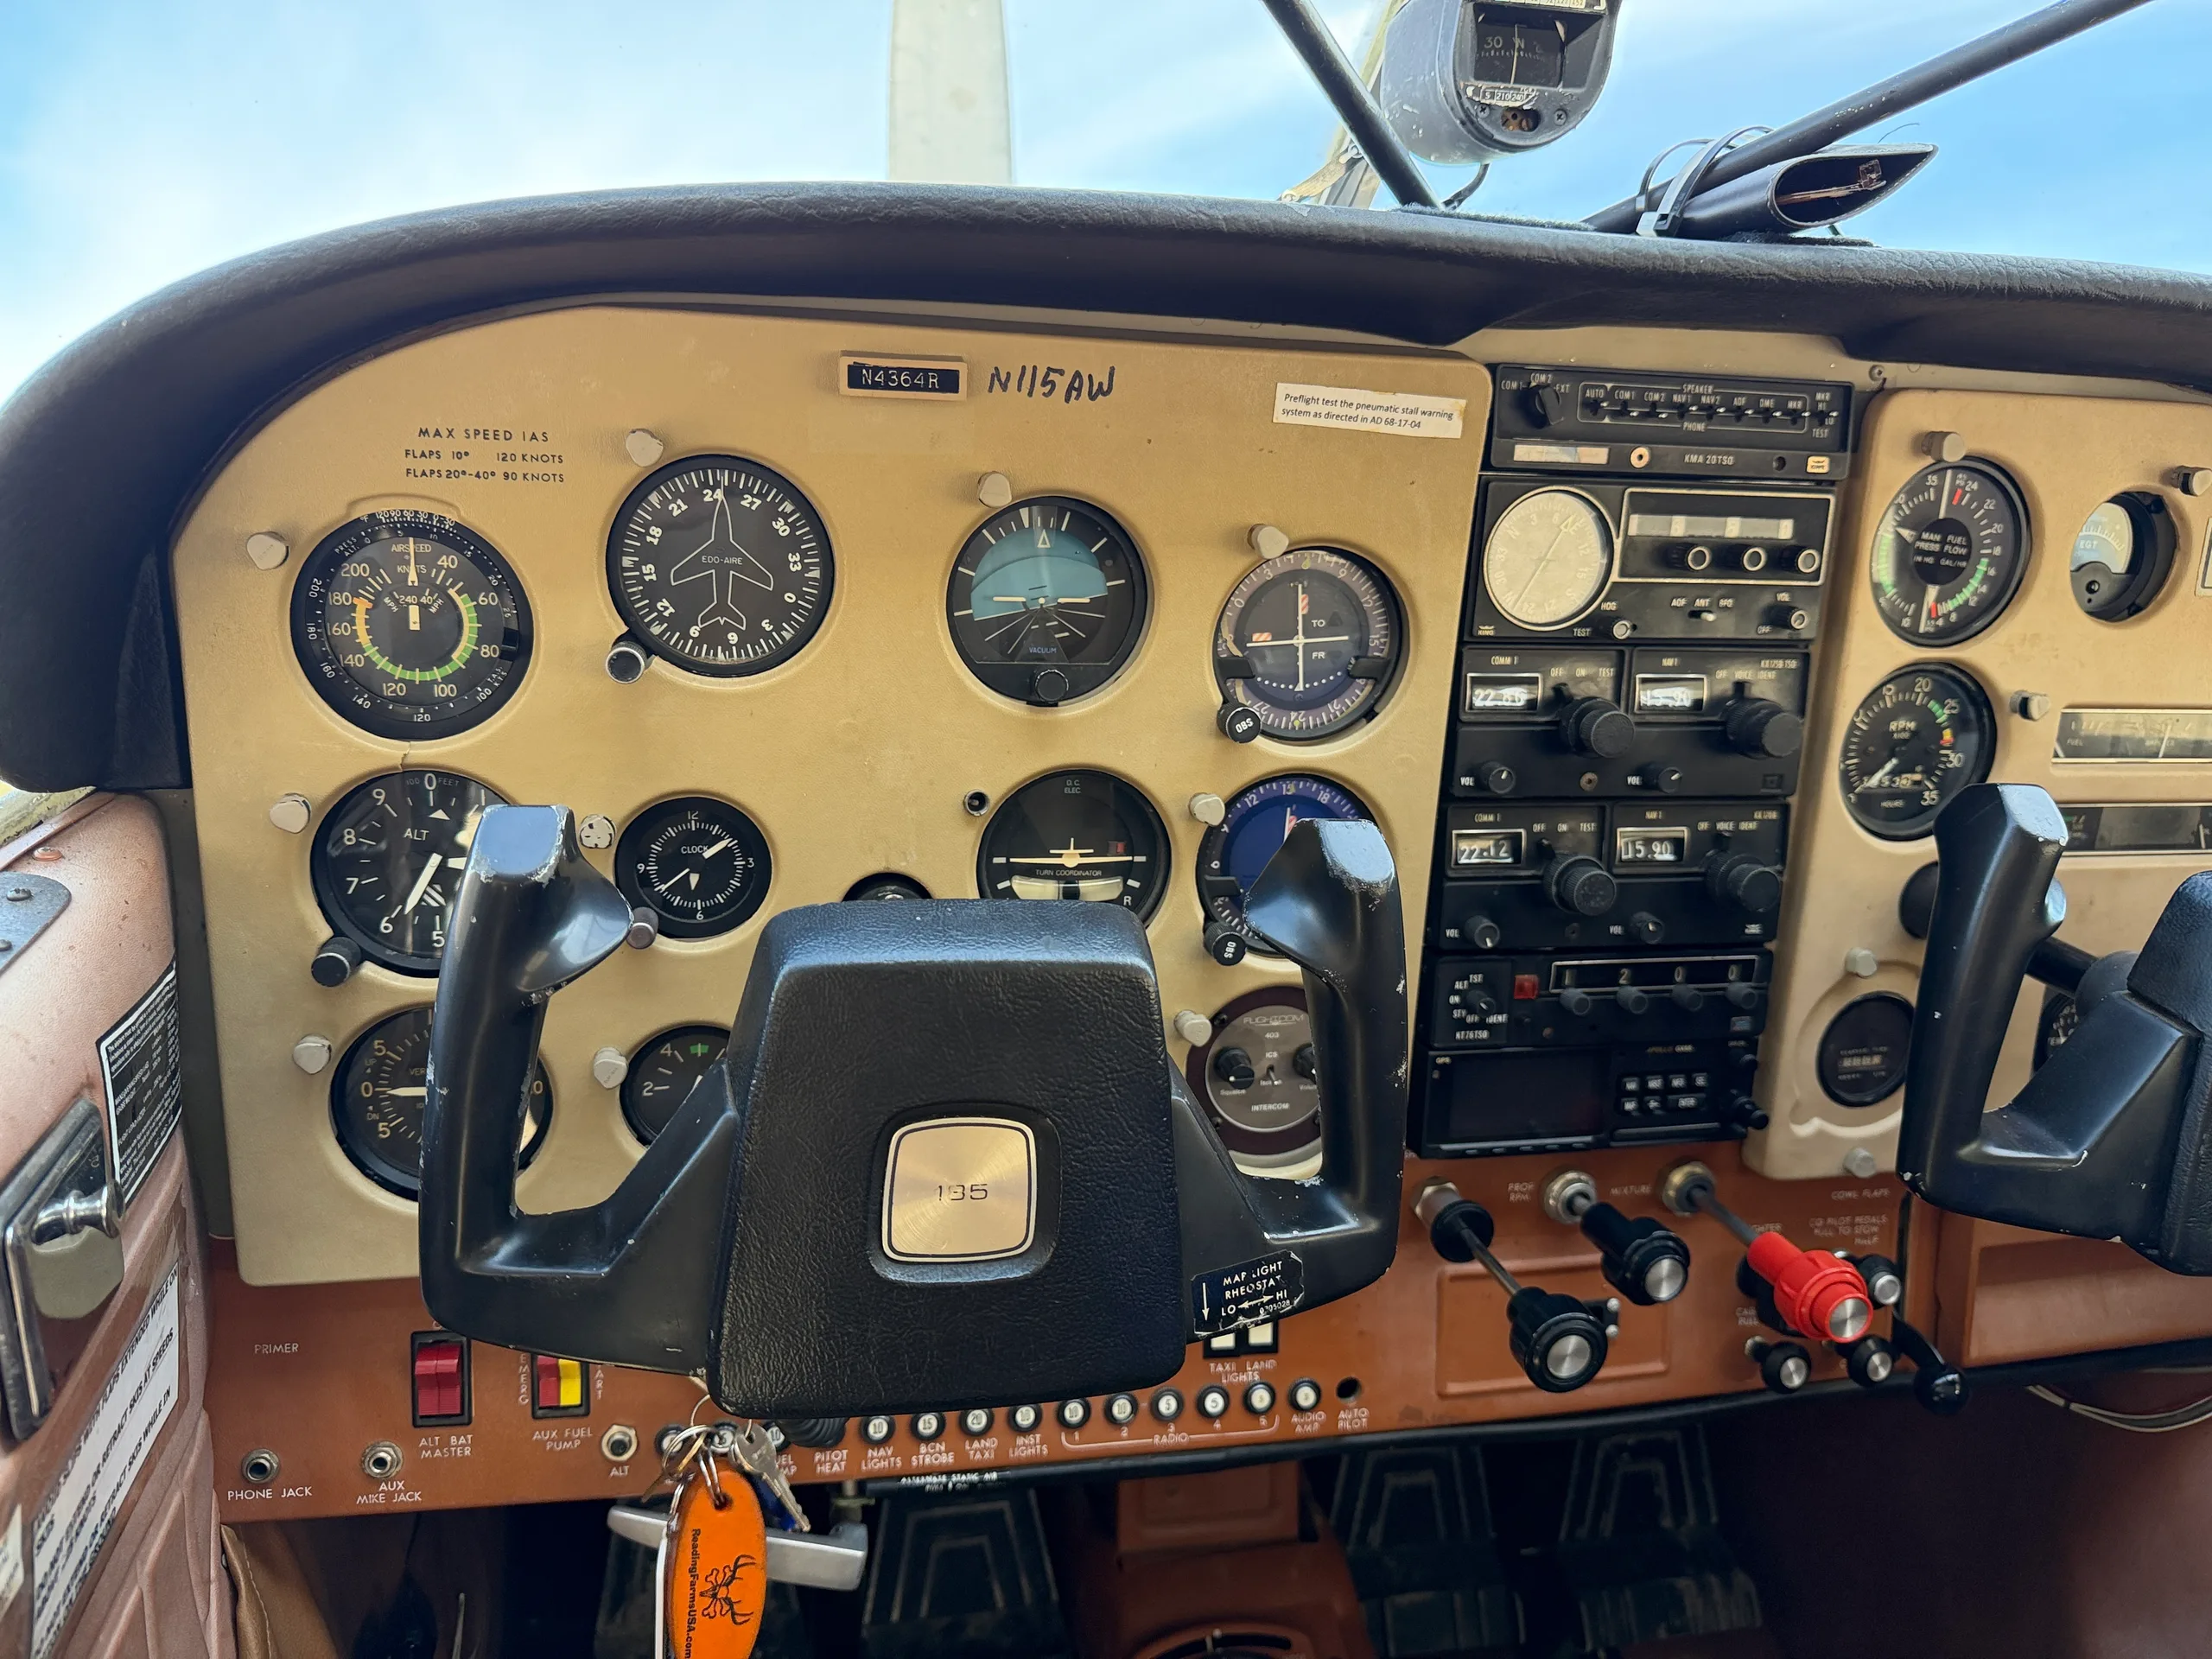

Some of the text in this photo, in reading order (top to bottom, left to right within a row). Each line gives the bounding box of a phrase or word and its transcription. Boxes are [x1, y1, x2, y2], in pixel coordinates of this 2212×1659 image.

[1484, 36, 1503, 48] 30
[861, 369, 939, 389] N4364R
[988, 365, 1116, 404] N115AW
[1502, 380, 1517, 390] COM
[1530, 373, 1546, 384] COM
[1556, 385, 1570, 393] EXT
[1586, 389, 1605, 398] AUTO
[1615, 391, 1630, 399] COM
[1683, 385, 1713, 393] SPEAKER
[1284, 393, 1453, 421] Preflight test the pneumatic stall warning
[1281, 408, 1311, 417] system
[1324, 411, 1358, 422] directed
[1361, 415, 1368, 423] in
[1370, 416, 1382, 425] AD
[1384, 418, 1421, 429] 68-17-04
[1683, 422, 1707, 431] PHONE
[418, 428, 549, 442] MAX SPEED IAS
[1813, 429, 1829, 438] TEST
[405, 449, 442, 460] FLAPS
[497, 453, 516, 461] 120
[522, 454, 563, 463] KNOTS
[406, 468, 442, 478] FLAPS
[523, 473, 563, 482] KNOTS
[1965, 482, 1978, 491] 24
[702, 489, 722, 502] 24
[741, 494, 761, 510] 27
[669, 499, 688, 517] 21
[1984, 499, 1996, 509] 22
[772, 518, 790, 537] 30
[1992, 524, 2003, 533] 20
[646, 526, 662, 545] 18
[1947, 535, 1967, 544] FUEL
[1915, 543, 1967, 555] PRESS FLOW
[2080, 540, 2098, 549] EGT
[437, 556, 458, 568] 40
[702, 556, 742, 564] EDO-AIRE
[788, 552, 802, 572] 33
[342, 564, 369, 576] 200
[642, 563, 657, 582] 15
[328, 592, 352, 605] 180
[479, 593, 497, 606] 60
[657, 599, 675, 617] 12
[327, 623, 351, 635] 160
[1573, 628, 1591, 637] TEST
[480, 645, 499, 658] 80
[340, 654, 364, 667] 140
[1491, 656, 1511, 664] COMM
[1599, 668, 1614, 677] TEST
[383, 683, 406, 696] 120
[434, 684, 457, 697] 100
[1915, 677, 1931, 692] 20
[1944, 699, 1960, 715] 25
[1236, 717, 1254, 734] OBS
[1890, 721, 1916, 732] RPM
[1947, 753, 1965, 767] 30
[424, 773, 437, 790] 0
[372, 789, 386, 806] 9
[1244, 794, 1259, 808] 12
[1921, 791, 1940, 805] 35
[687, 810, 698, 820] 12
[343, 829, 356, 845] 8
[404, 828, 429, 841] ALT
[637, 864, 645, 874] 9
[747, 858, 754, 868] 3
[346, 878, 359, 894] 7
[1123, 896, 1132, 906] R
[696, 912, 703, 920] 6
[379, 917, 393, 933] 6
[432, 931, 445, 948] 5
[1224, 941, 1237, 958] OBS
[373, 1040, 386, 1056] 5
[661, 1043, 672, 1057] 4
[361, 1082, 373, 1097] 0
[643, 1082, 653, 1096] 2
[1251, 1103, 1289, 1112] INTERCOM
[378, 1122, 391, 1139] 5
[1610, 1185, 1651, 1195] MIXTURE
[1252, 1262, 1282, 1277] LIGHT
[1225, 1275, 1281, 1300] RHEOSTAT
[1222, 1290, 1287, 1316] LO HI
[101, 1279, 169, 1410] FLAPS EXTENDED WHILE
[254, 1343, 299, 1354] PRIMER
[1210, 1360, 1277, 1372] TAXI LAND
[518, 1354, 530, 1405] EMERG
[1222, 1371, 1260, 1382] LIGHTS
[101, 1327, 174, 1467] RETRACT SKIS AT SPEEDS
[1291, 1411, 1326, 1423] AUDIO
[1338, 1408, 1370, 1419] AUTO
[1294, 1423, 1319, 1433] AMP
[1338, 1419, 1368, 1429] PILOT
[532, 1427, 593, 1440] AUX FUEL
[1016, 1434, 1041, 1446] INST
[1154, 1433, 1189, 1446] RADIO
[419, 1435, 473, 1446] ALT BAT
[546, 1440, 581, 1451] PUMP
[919, 1441, 945, 1453] BCN
[965, 1438, 997, 1451] LAND
[421, 1447, 471, 1459] MASTER
[814, 1449, 849, 1462] PITOT
[868, 1446, 893, 1459] NAV
[912, 1452, 954, 1466] STROBE
[969, 1450, 995, 1459] TAXI
[1009, 1446, 1048, 1459] LIGHTS
[99, 1400, 162, 1527] RETRACT SKIS WHILE
[817, 1461, 846, 1473] HEAT
[861, 1457, 902, 1470] LIGHTS
[609, 1465, 630, 1477] ALT
[379, 1481, 405, 1491] AUX
[227, 1486, 313, 1500] PHONE JACK
[356, 1491, 422, 1504] MIKE JACK
[684, 1528, 701, 1659] ReadingFarmsUSA.com
